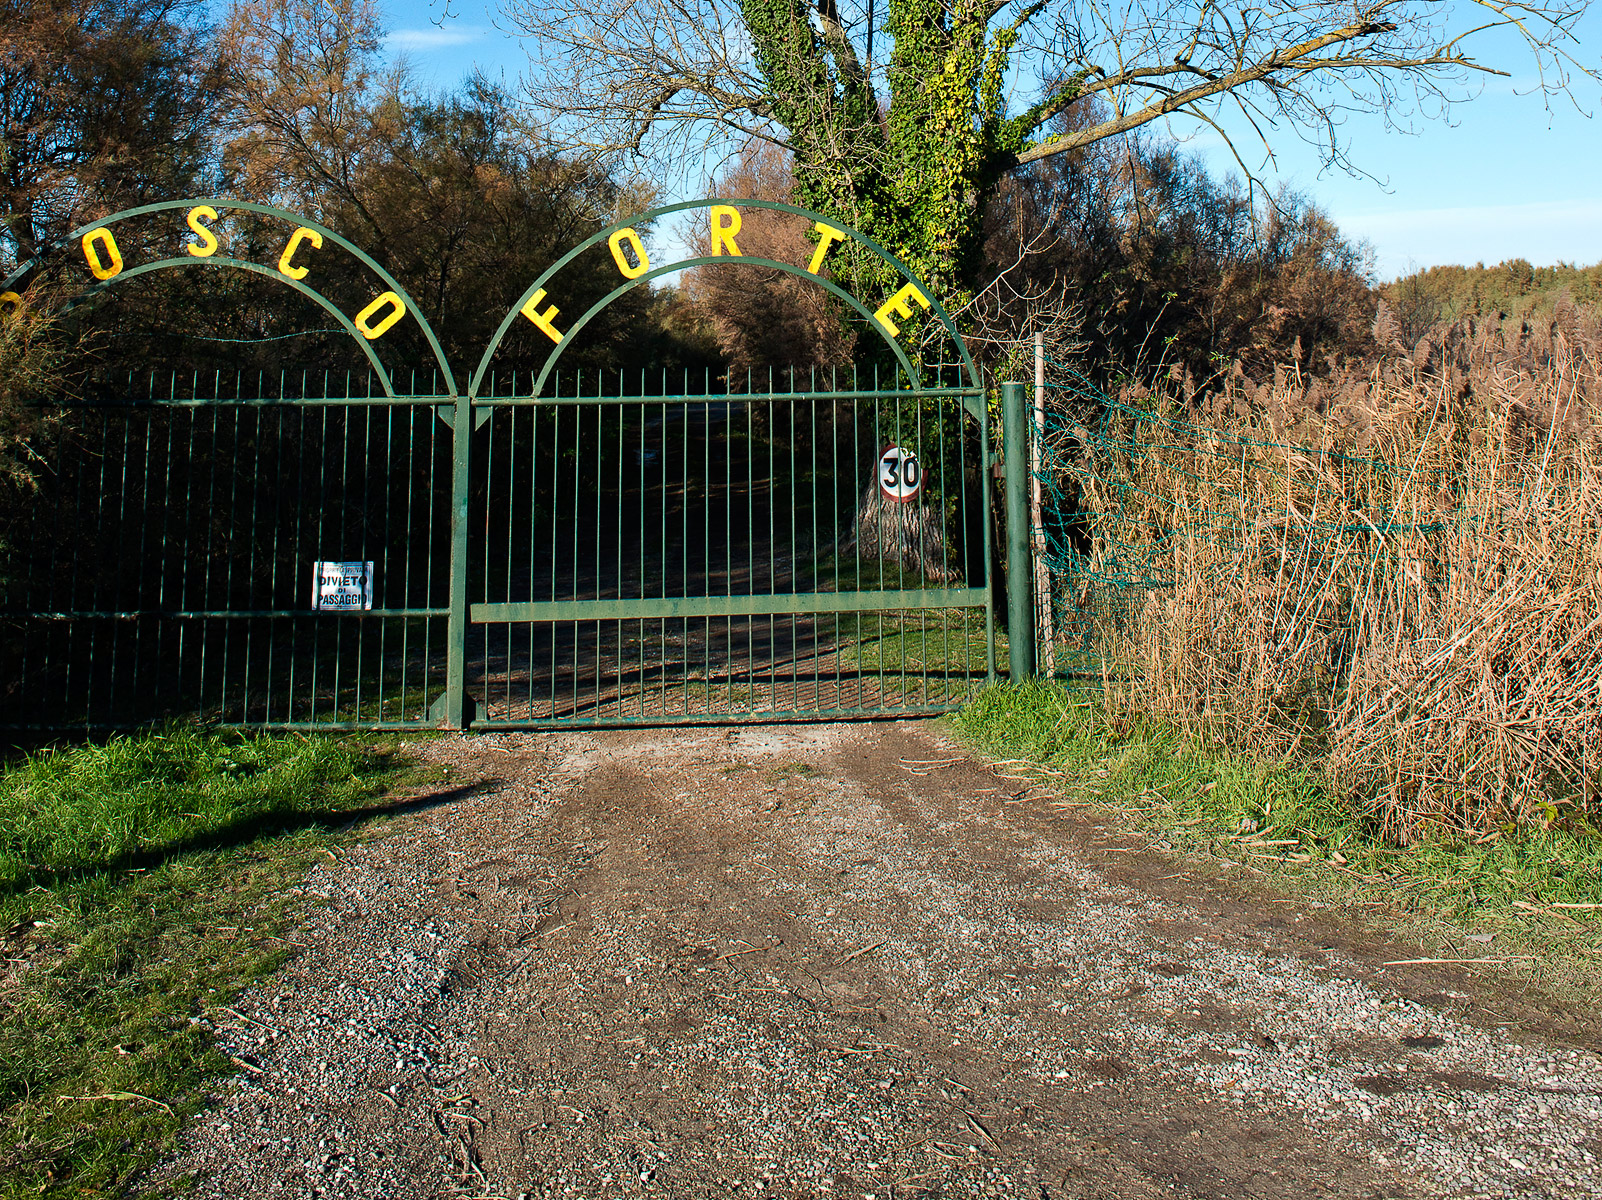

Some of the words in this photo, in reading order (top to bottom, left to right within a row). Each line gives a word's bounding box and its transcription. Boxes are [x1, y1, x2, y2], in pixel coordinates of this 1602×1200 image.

[520, 205, 931, 344] FORTE
[883, 457, 919, 488] 30
[320, 576, 367, 587] DIVIETO
